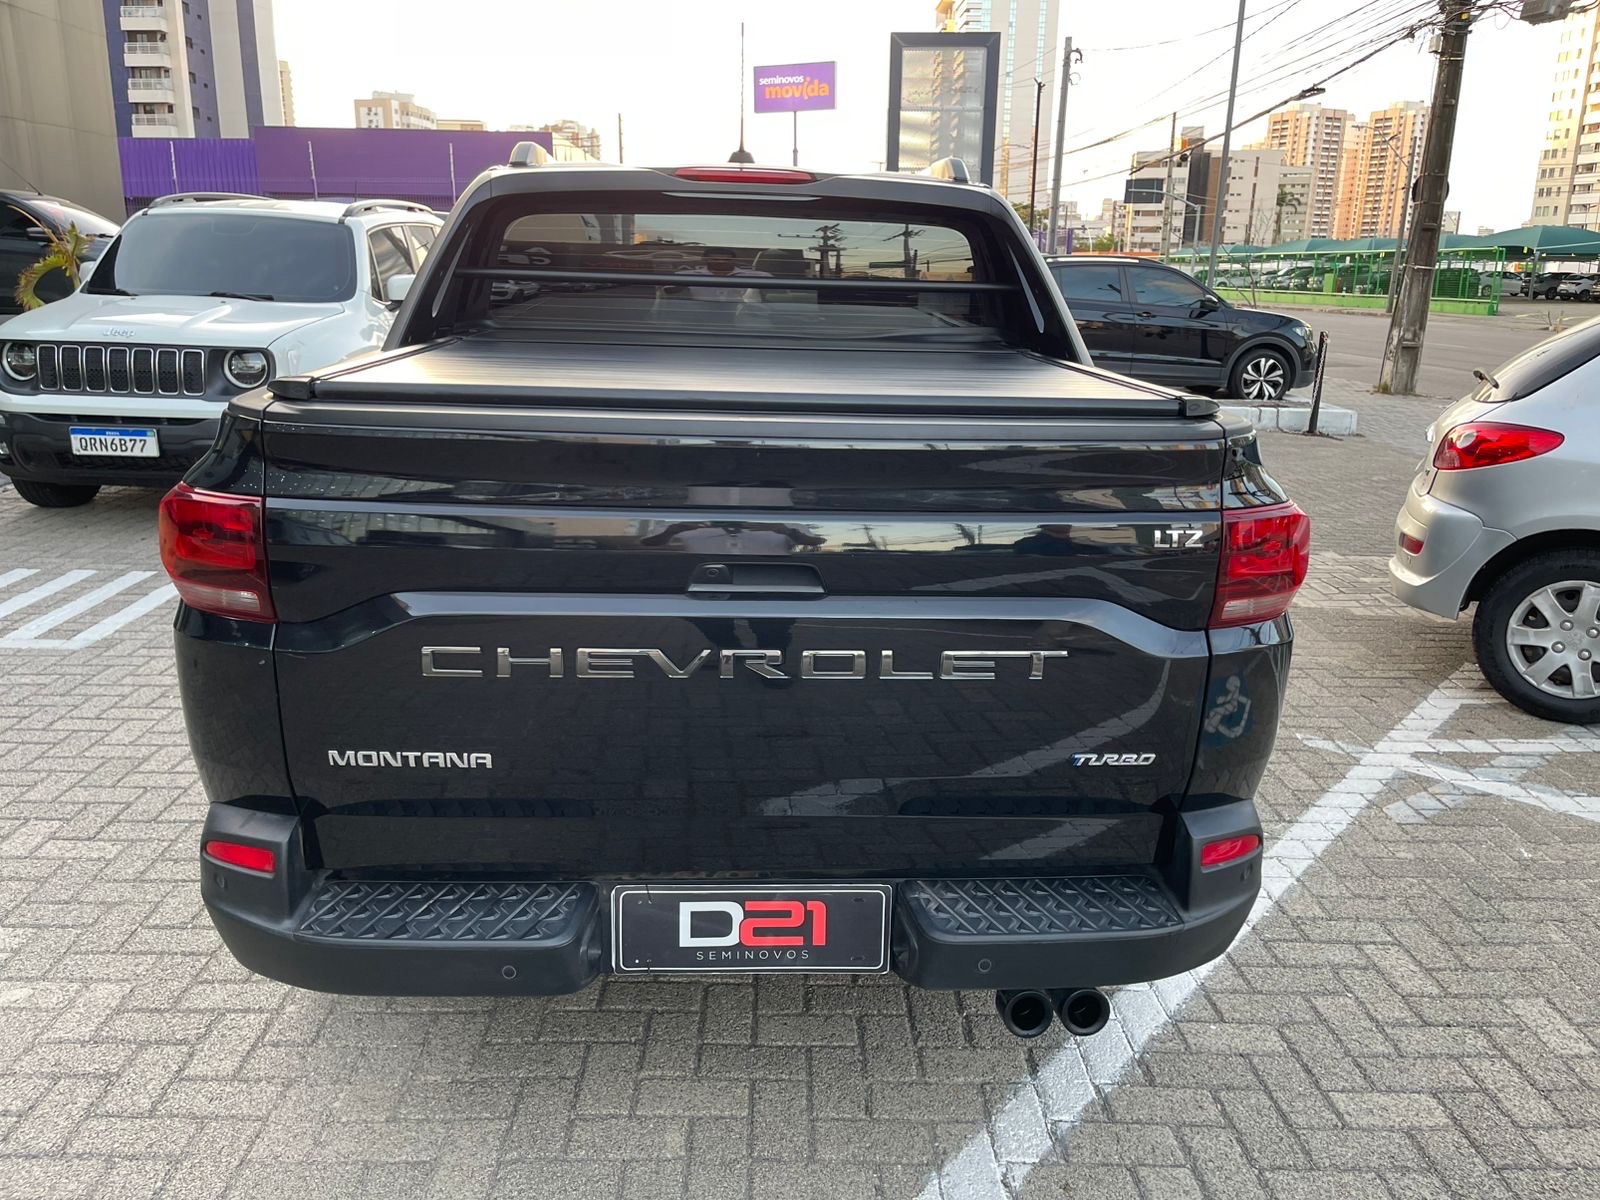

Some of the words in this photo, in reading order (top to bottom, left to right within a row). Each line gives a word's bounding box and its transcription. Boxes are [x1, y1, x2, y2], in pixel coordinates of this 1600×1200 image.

[759, 75, 804, 85] seminovos
[765, 77, 829, 100] movida
[80, 437, 146, 452] QRN6B77
[1154, 529, 1204, 548] LTZ
[421, 646, 1069, 679] CHEVROLET
[327, 750, 493, 769] MONTANA
[1072, 753, 1157, 767] TURBO
[679, 901, 827, 947] D21
[696, 950, 809, 960] SEMINOVOS
